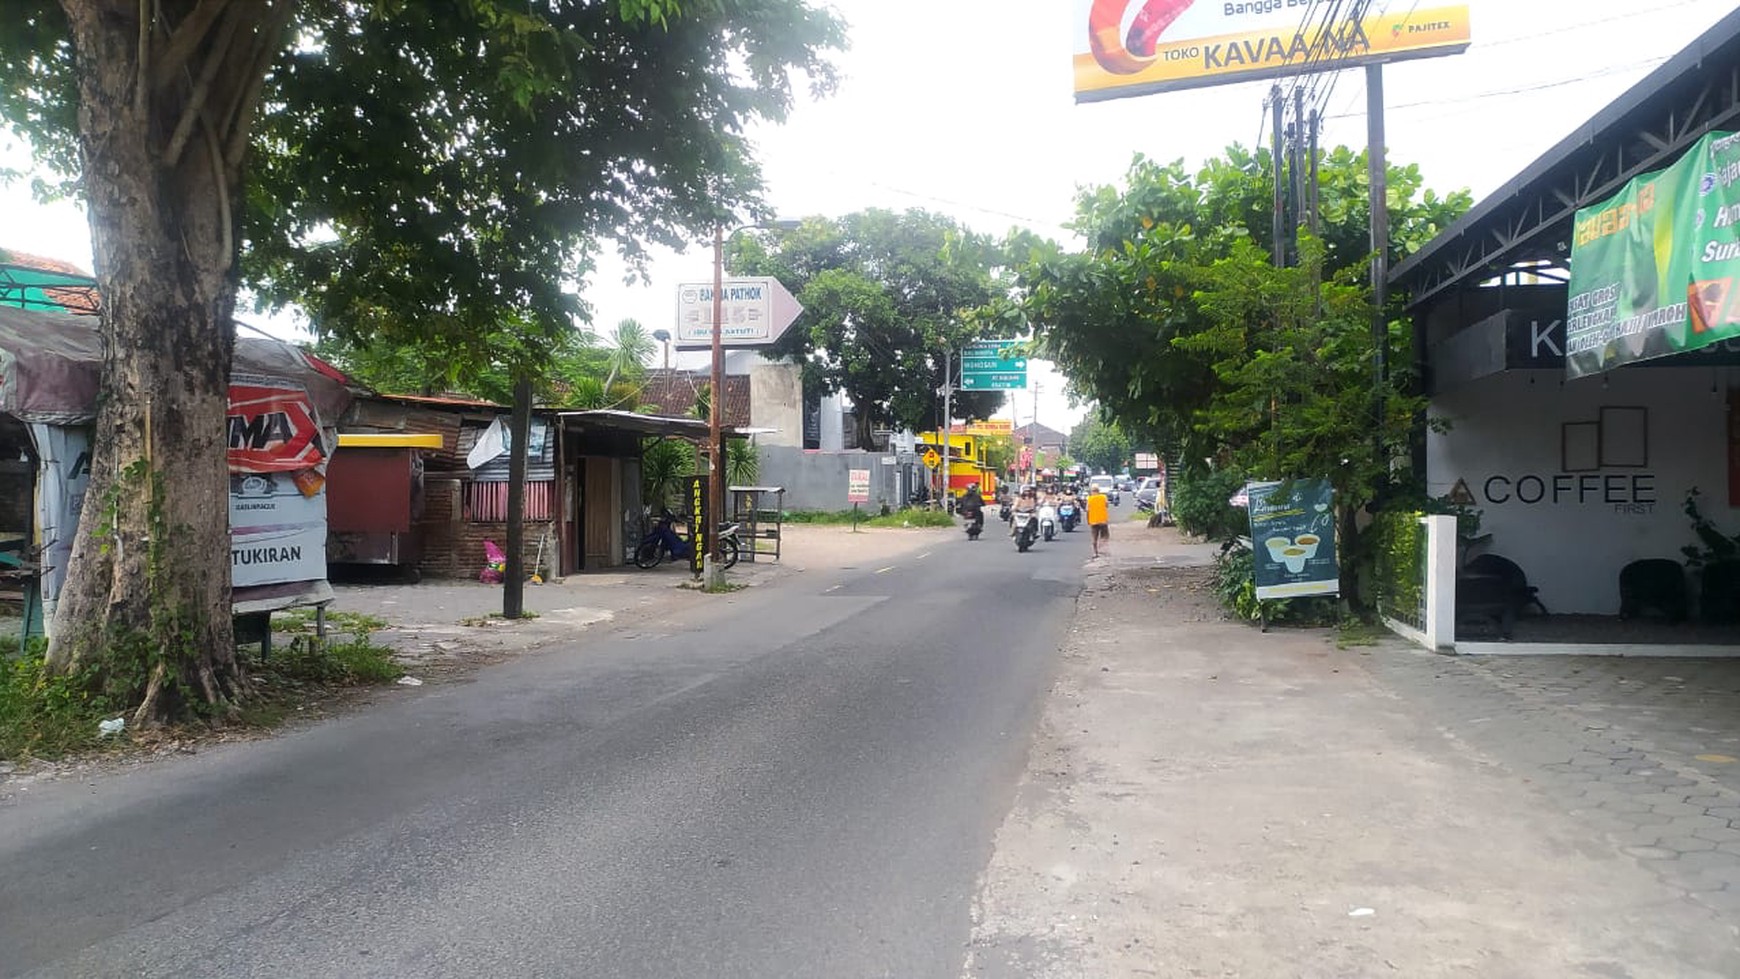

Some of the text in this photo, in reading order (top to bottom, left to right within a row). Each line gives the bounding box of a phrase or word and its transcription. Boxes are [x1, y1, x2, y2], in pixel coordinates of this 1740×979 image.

[1408, 21, 1450, 34] PAJITEX
[1163, 46, 1200, 62] TOKO
[731, 287, 762, 300] PATHOK
[1483, 475, 1656, 504] COFFEE
[1614, 503, 1656, 513] FIRST
[692, 479, 705, 570] ANGKRINGAN
[231, 545, 302, 566] TUKIRAN
